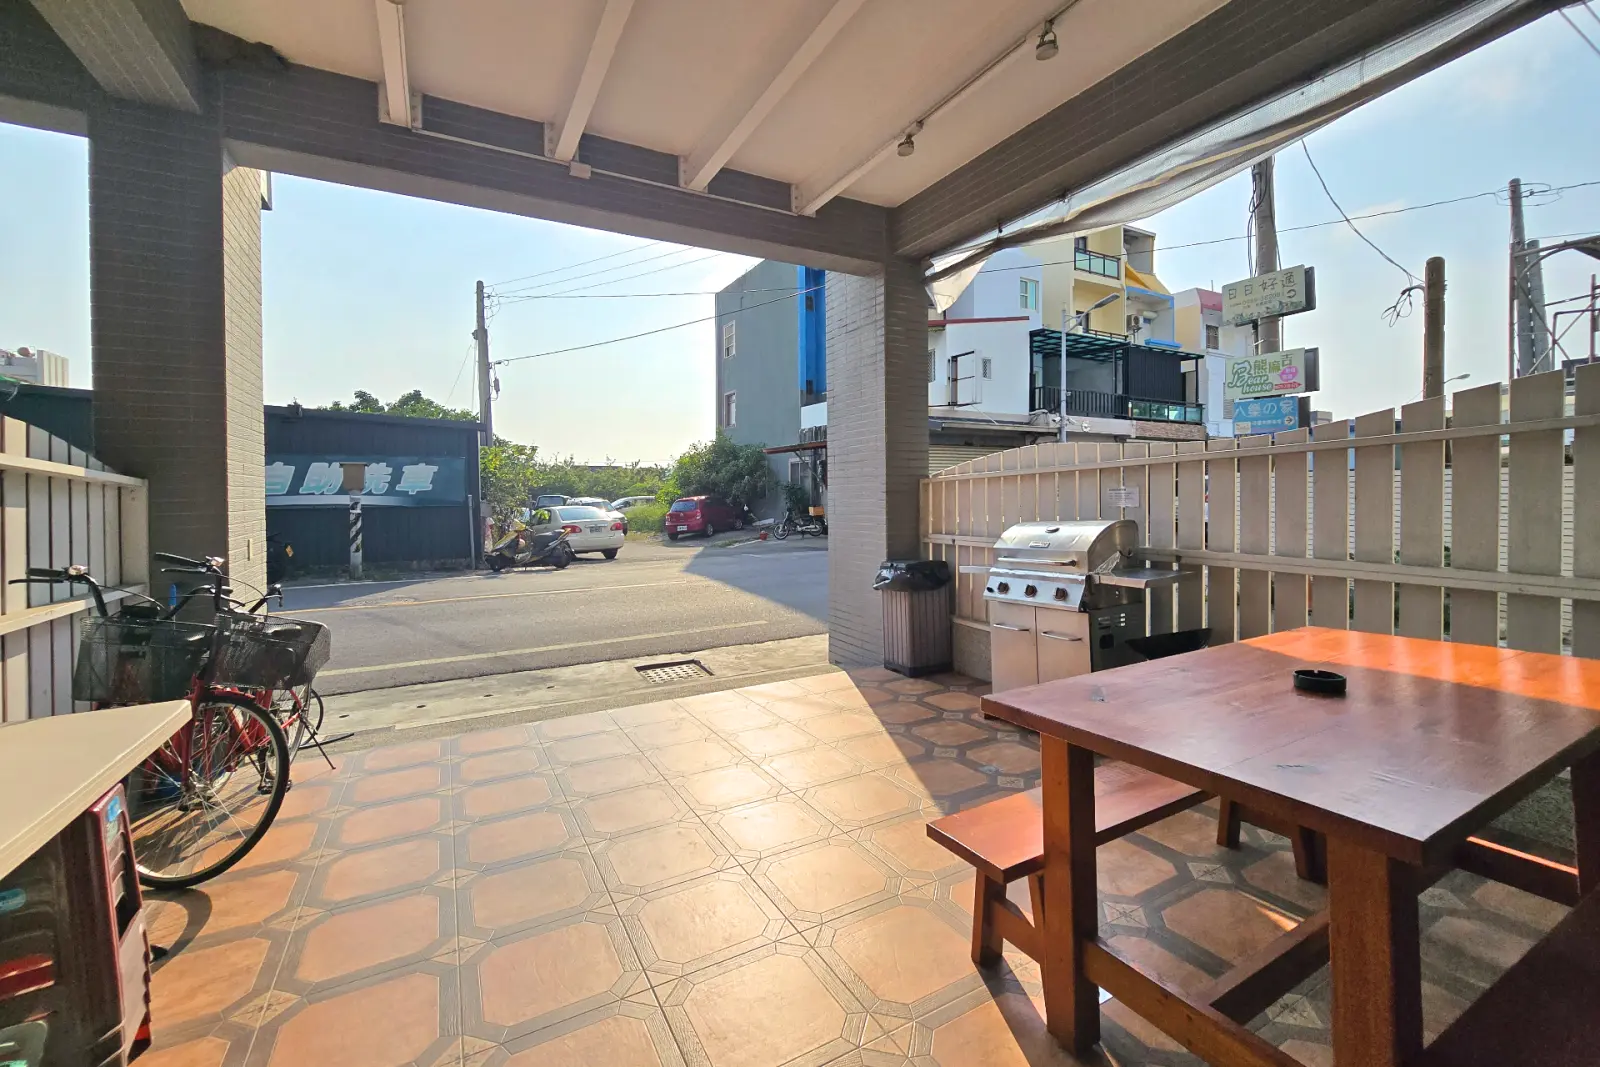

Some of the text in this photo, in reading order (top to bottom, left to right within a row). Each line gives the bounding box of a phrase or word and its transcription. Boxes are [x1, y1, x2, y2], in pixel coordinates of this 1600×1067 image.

[1228, 271, 1298, 300] 日日好適
[1228, 362, 1268, 388] Bear
[1242, 382, 1273, 394] house
[265, 462, 438, 495] 自助洗車
